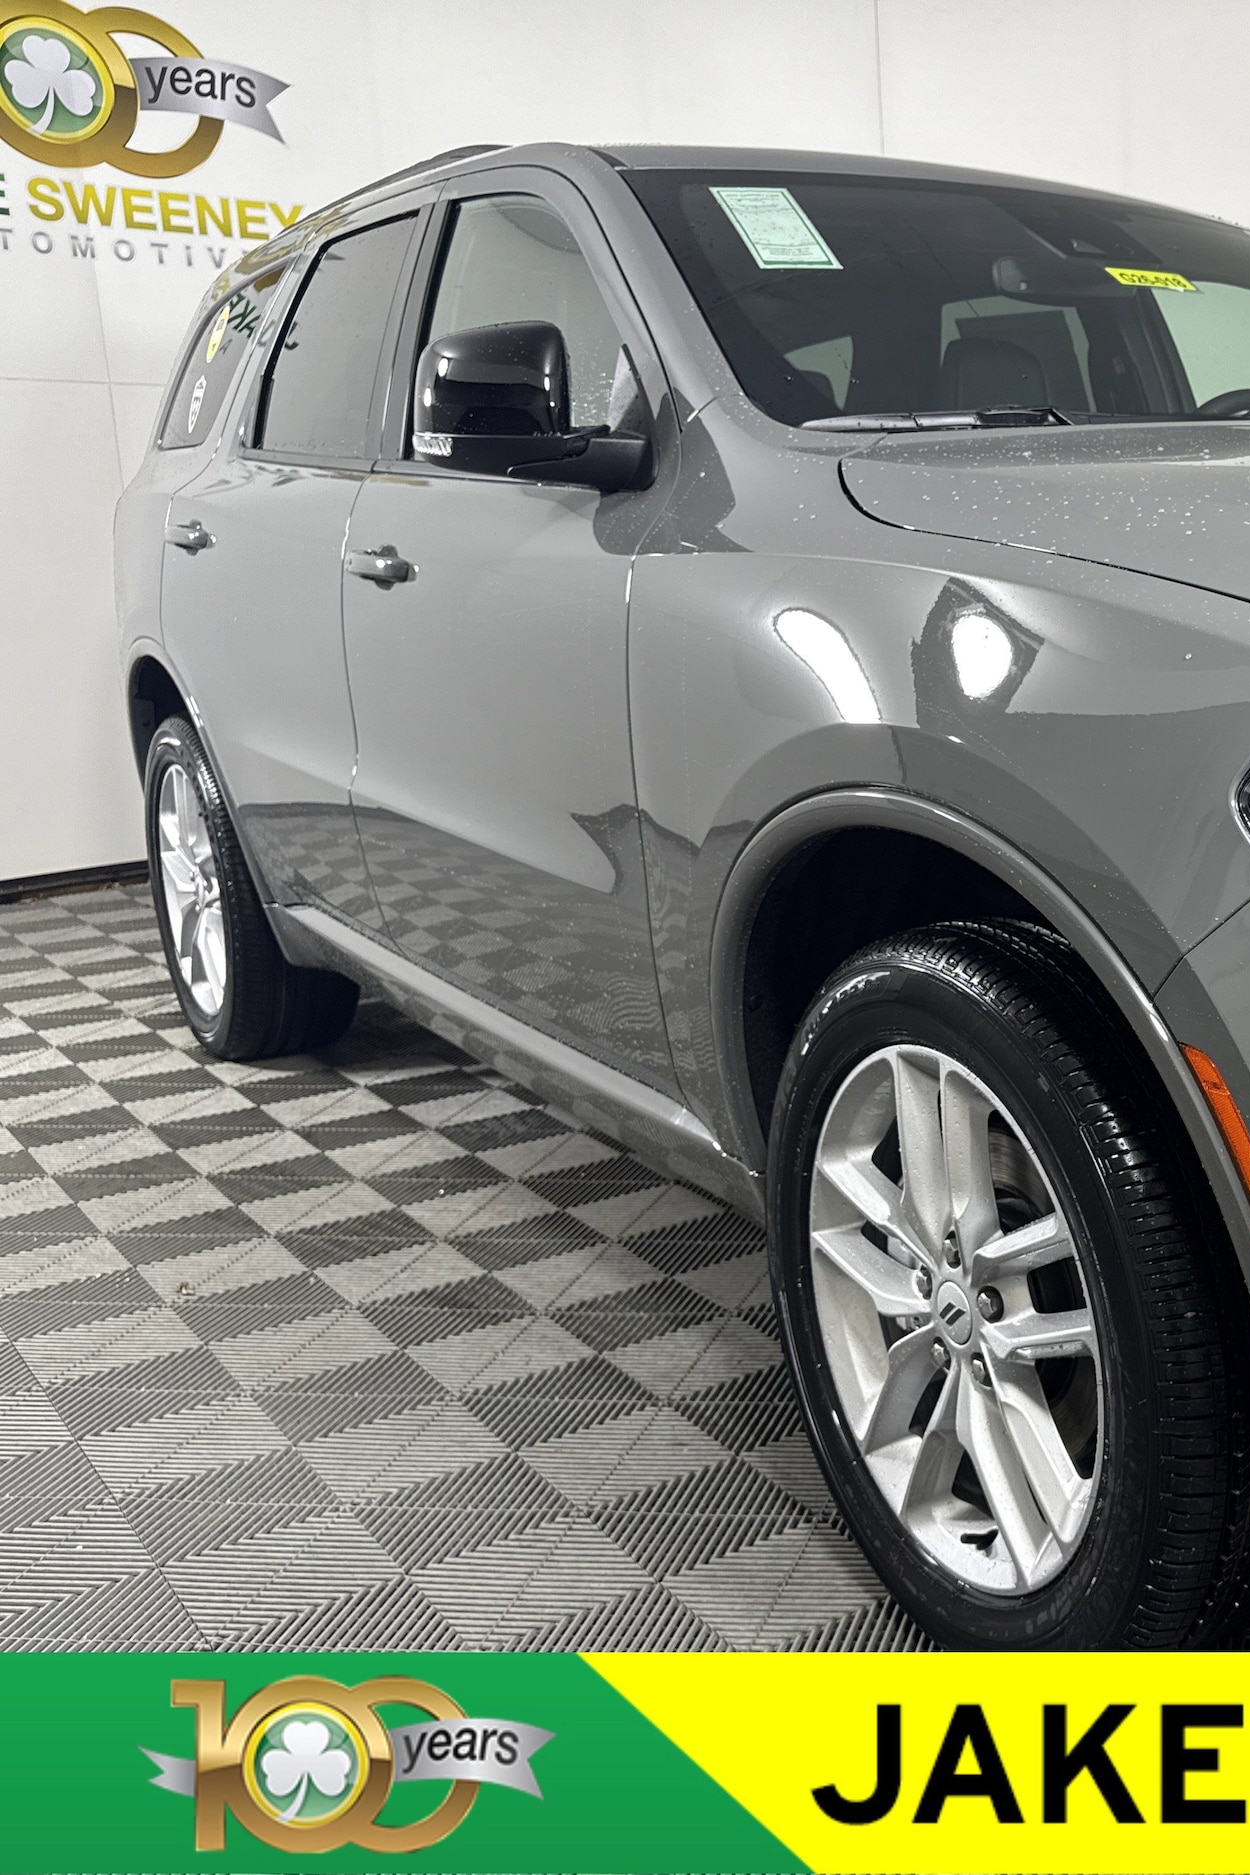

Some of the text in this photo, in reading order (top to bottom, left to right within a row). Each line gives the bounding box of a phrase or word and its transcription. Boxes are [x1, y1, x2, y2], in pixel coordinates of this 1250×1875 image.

[145, 66, 256, 108] years
[27, 177, 303, 240] SWEENEY
[0, 228, 243, 269] TOMOTIV
